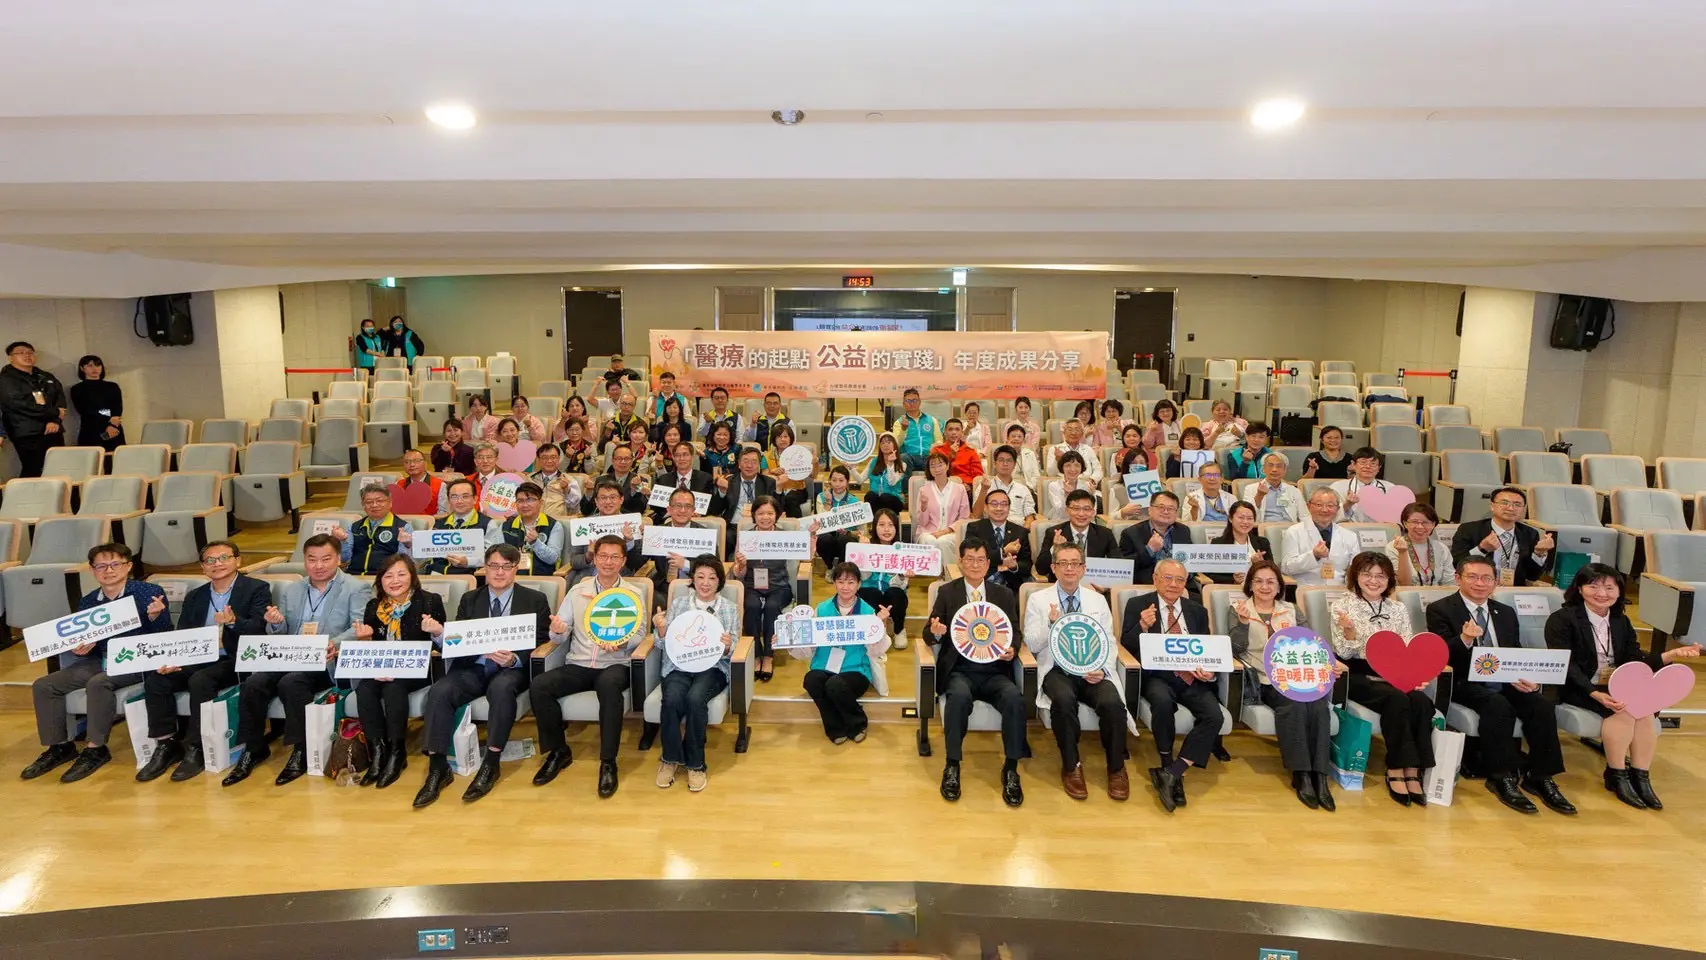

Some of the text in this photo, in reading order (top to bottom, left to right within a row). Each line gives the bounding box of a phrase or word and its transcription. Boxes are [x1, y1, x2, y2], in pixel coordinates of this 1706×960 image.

[847, 277, 871, 287] 14:53
[953, 350, 1082, 372] 年度成果分享
[489, 484, 516, 500] 公益台
[1127, 480, 1162, 500] ESG
[432, 532, 462, 545] ESG
[868, 552, 932, 571] 守護病安
[1190, 552, 1247, 561] 屏東榮民總醫院
[56, 607, 111, 638] ESG
[815, 619, 855, 631] 智慧醫起
[30, 617, 140, 657] 社團法人亞太ESG行動聯盟
[597, 627, 627, 637] 屏東縣
[826, 631, 866, 642] 幸福屏東
[1165, 638, 1204, 656] ESG
[339, 658, 427, 669] 新竹榮譽國民之家
[1271, 649, 1329, 665] 公益台灣
[1272, 667, 1330, 682] 溫暖屏東
